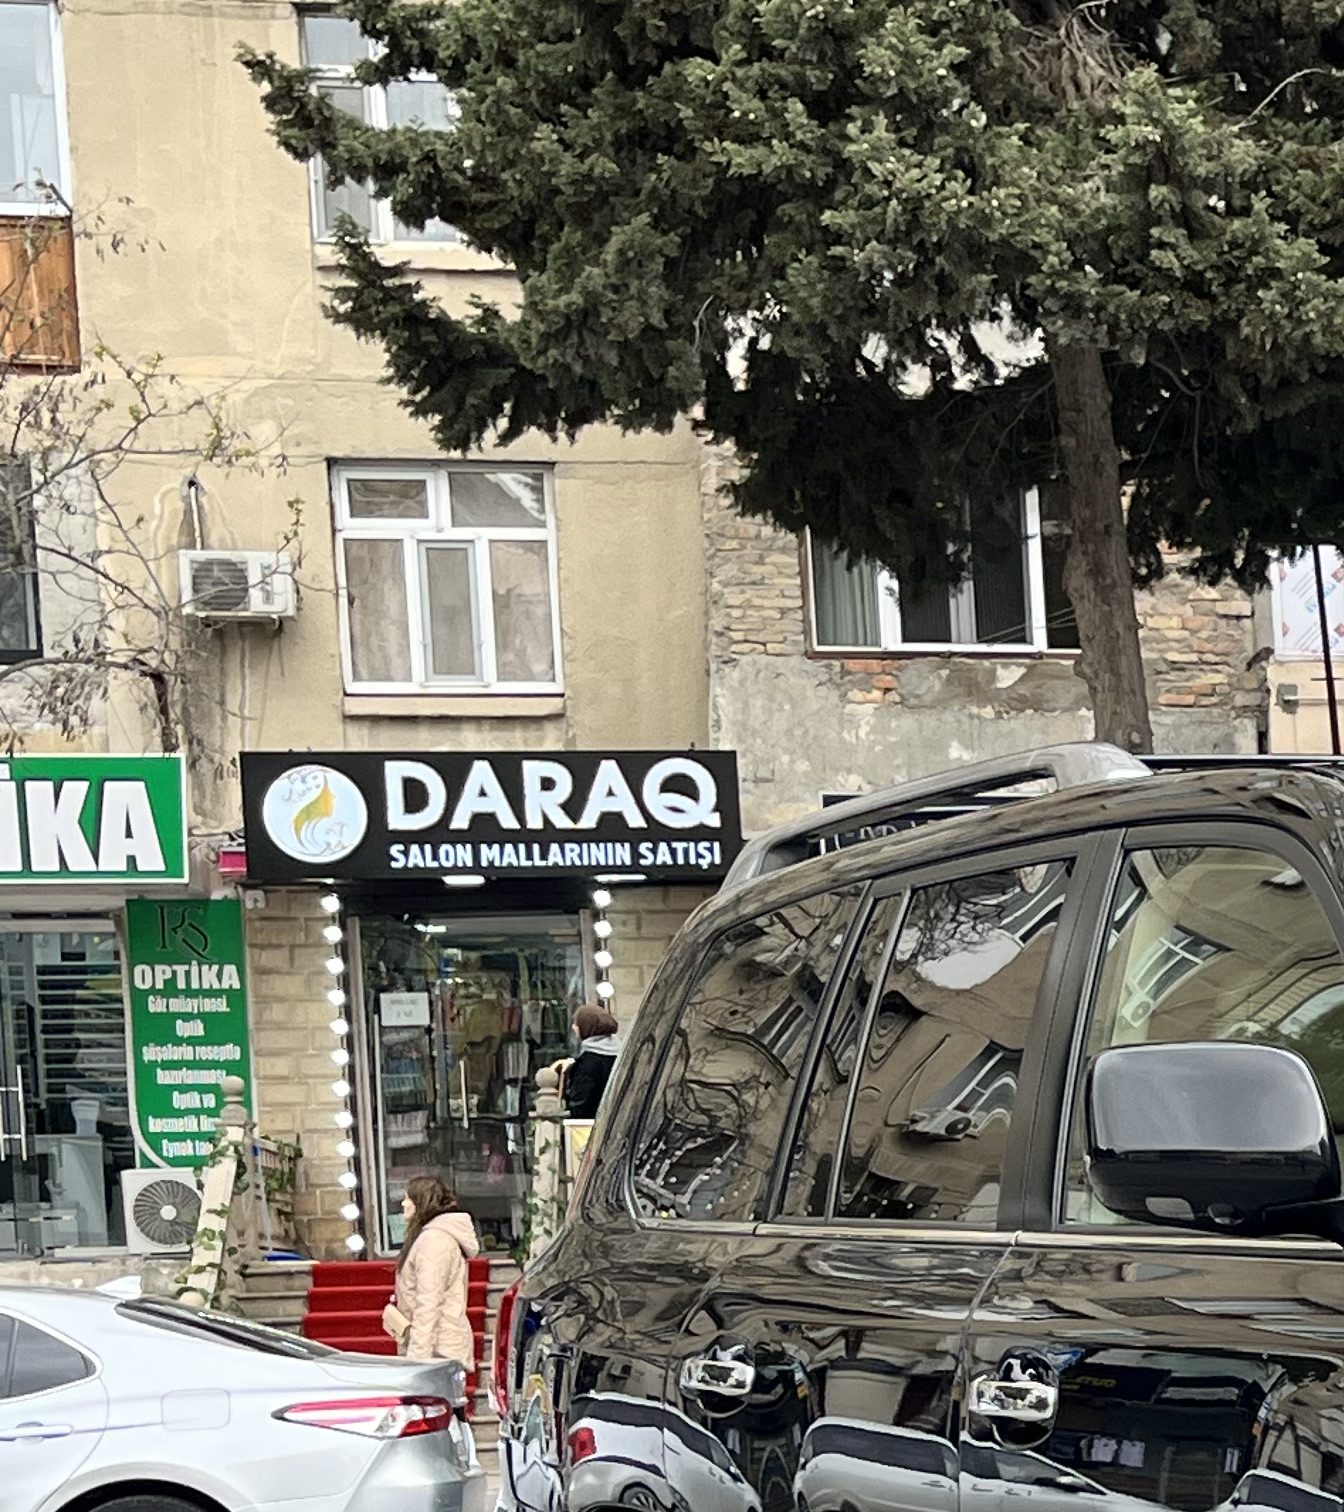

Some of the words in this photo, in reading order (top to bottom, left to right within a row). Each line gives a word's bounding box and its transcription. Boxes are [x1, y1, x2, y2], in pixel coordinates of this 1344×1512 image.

[383, 757, 721, 831] DARAQ
[389, 842, 472, 869] SALON
[480, 841, 632, 868] MALLARININ
[638, 841, 721, 871] SATIŞI
[133, 960, 241, 990] OPTİKA
